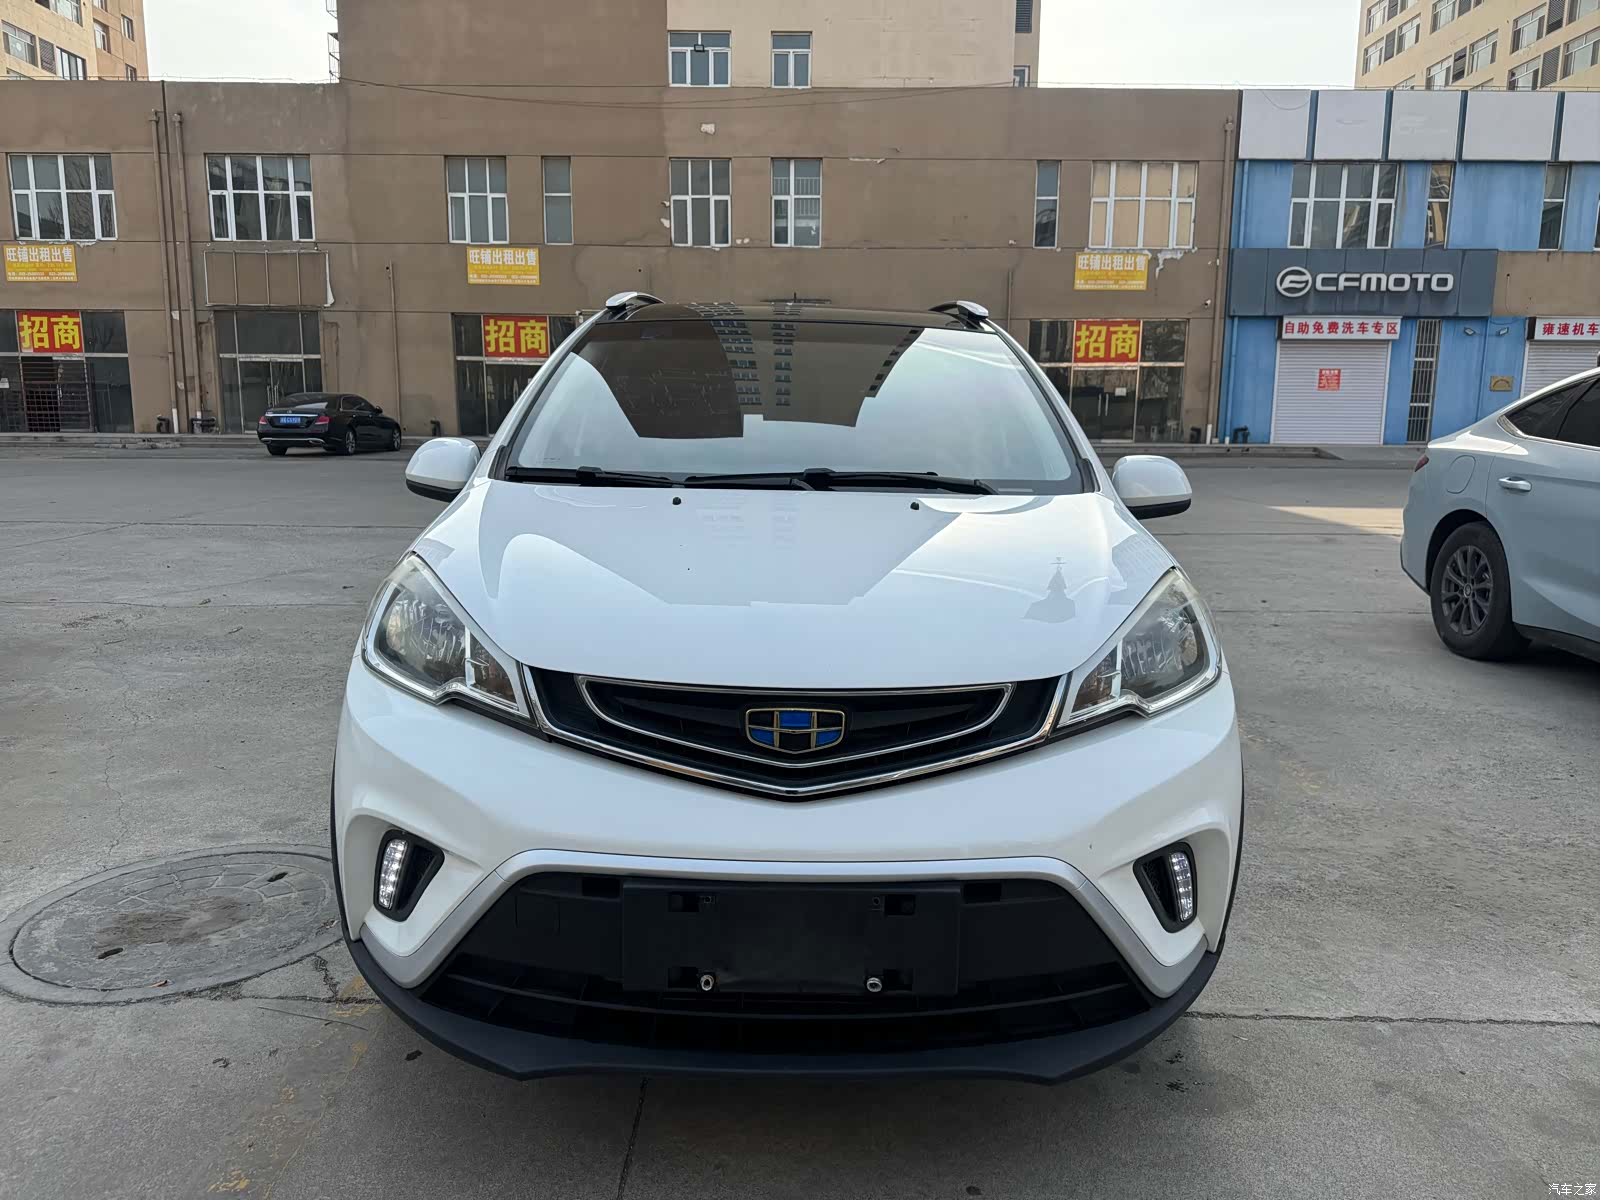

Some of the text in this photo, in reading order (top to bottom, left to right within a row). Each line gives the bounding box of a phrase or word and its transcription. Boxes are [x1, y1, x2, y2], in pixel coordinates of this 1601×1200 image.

[6, 247, 72, 262] 旺铺出租出售
[469, 249, 536, 265] 旺铺出租出售
[1078, 255, 1146, 271] 旺铺出租出售
[1315, 273, 1454, 292] CFMOTO
[19, 314, 80, 350] 招商
[1284, 321, 1399, 335] 自助免费洗车专区
[1542, 322, 1600, 336] 雍速机车
[485, 319, 547, 354] 招商
[1076, 324, 1140, 359] 招商
